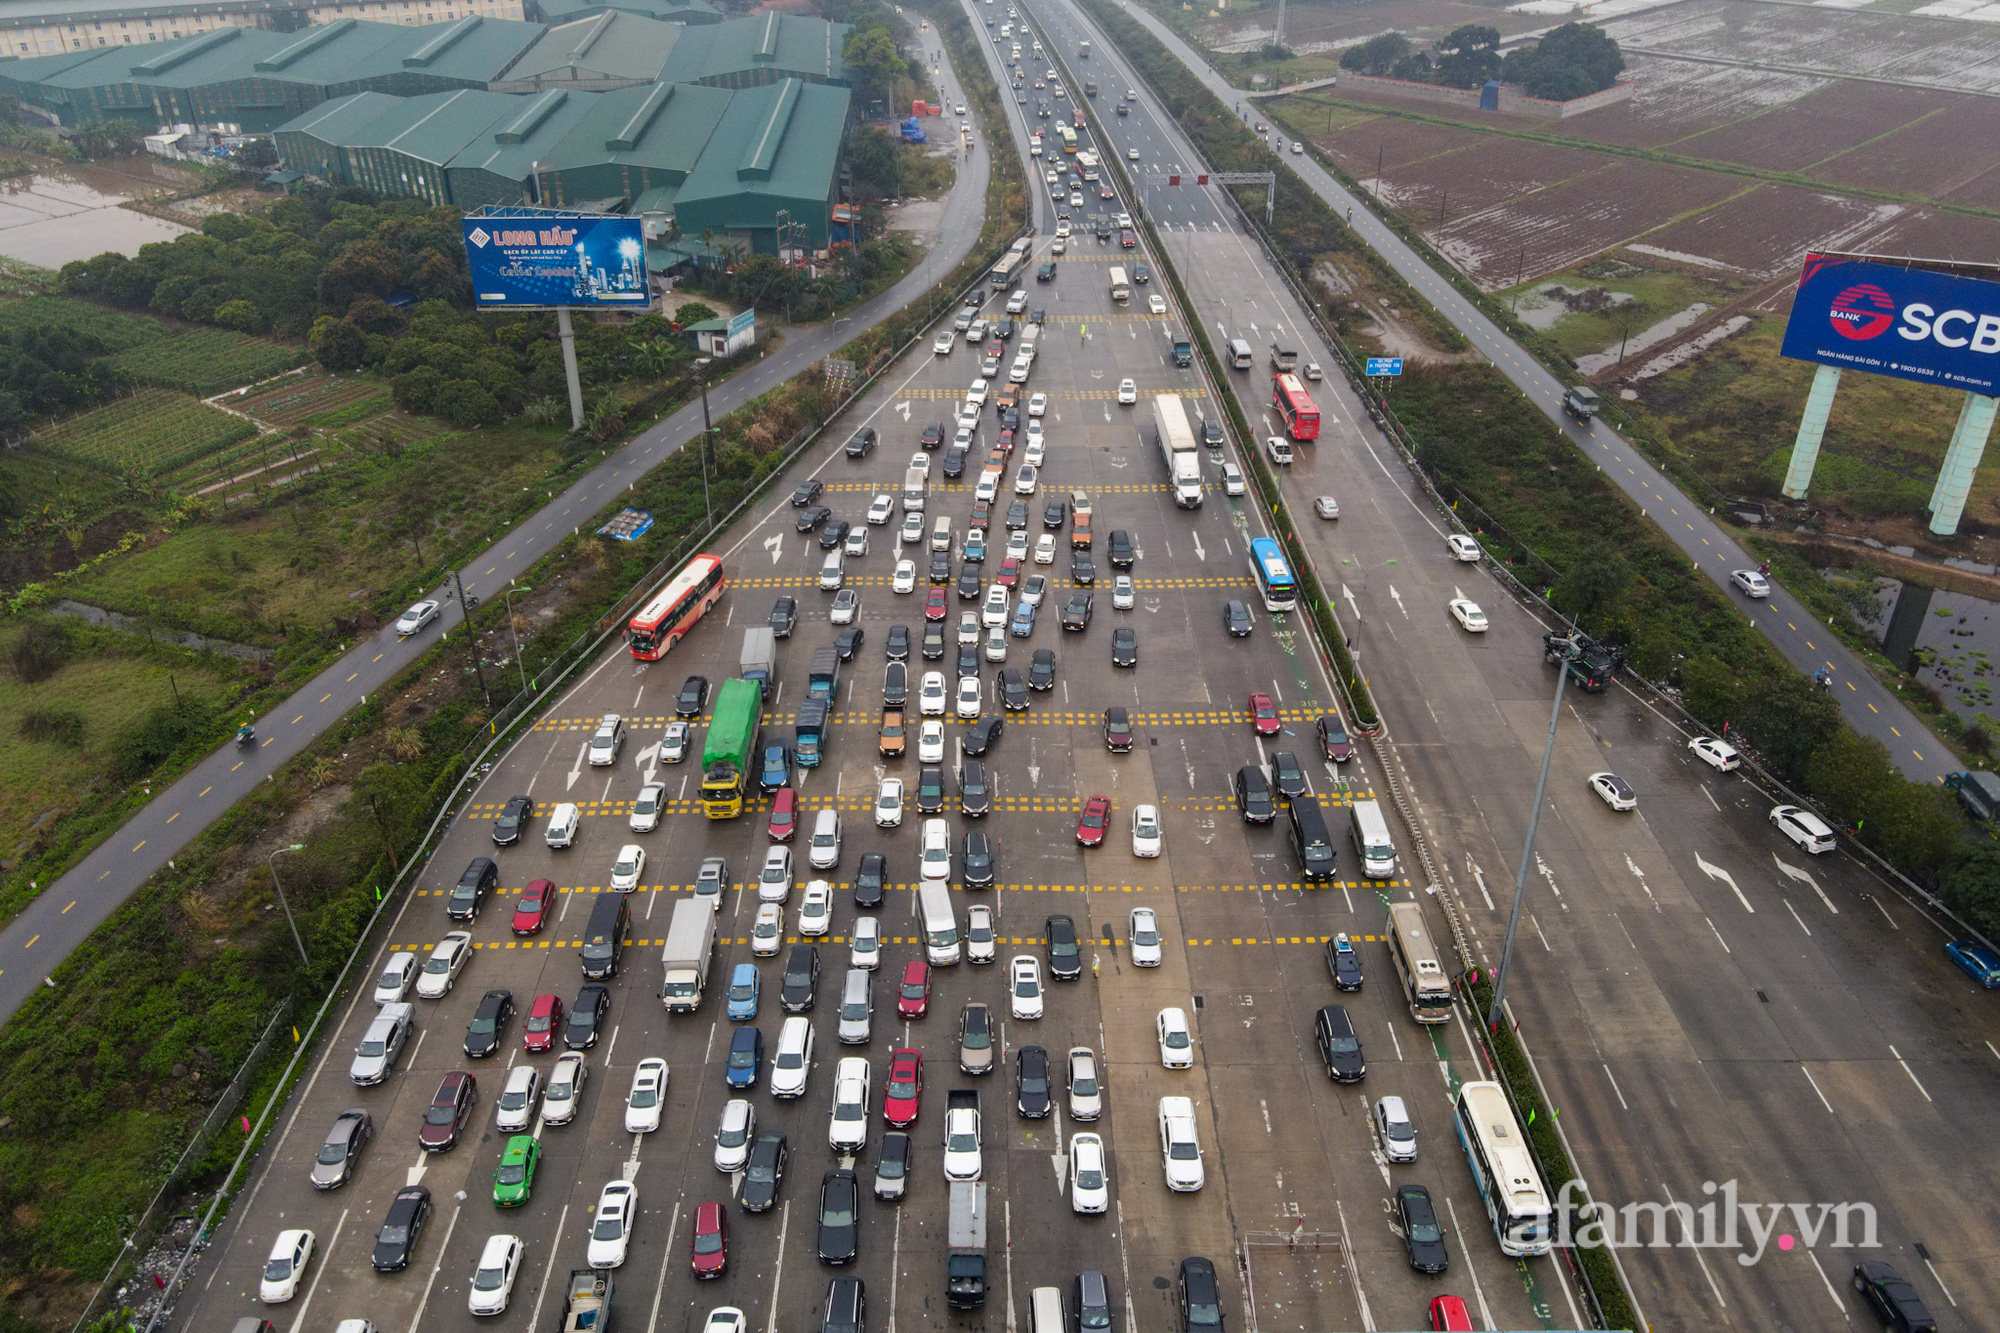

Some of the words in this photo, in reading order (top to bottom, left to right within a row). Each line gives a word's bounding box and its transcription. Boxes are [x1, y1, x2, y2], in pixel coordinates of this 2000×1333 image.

[493, 231, 537, 246] LONG
[1830, 310, 1861, 322] BANK
[1897, 303, 2000, 354] SCB
[1817, 349, 1836, 358] NGÂN
[1835, 353, 1854, 362] HÀNG
[1854, 356, 1866, 364] SÀI
[1865, 358, 1881, 366] GÒN
[1900, 364, 1917, 373] 1900
[1952, 375, 1992, 387] scb.com.vn
